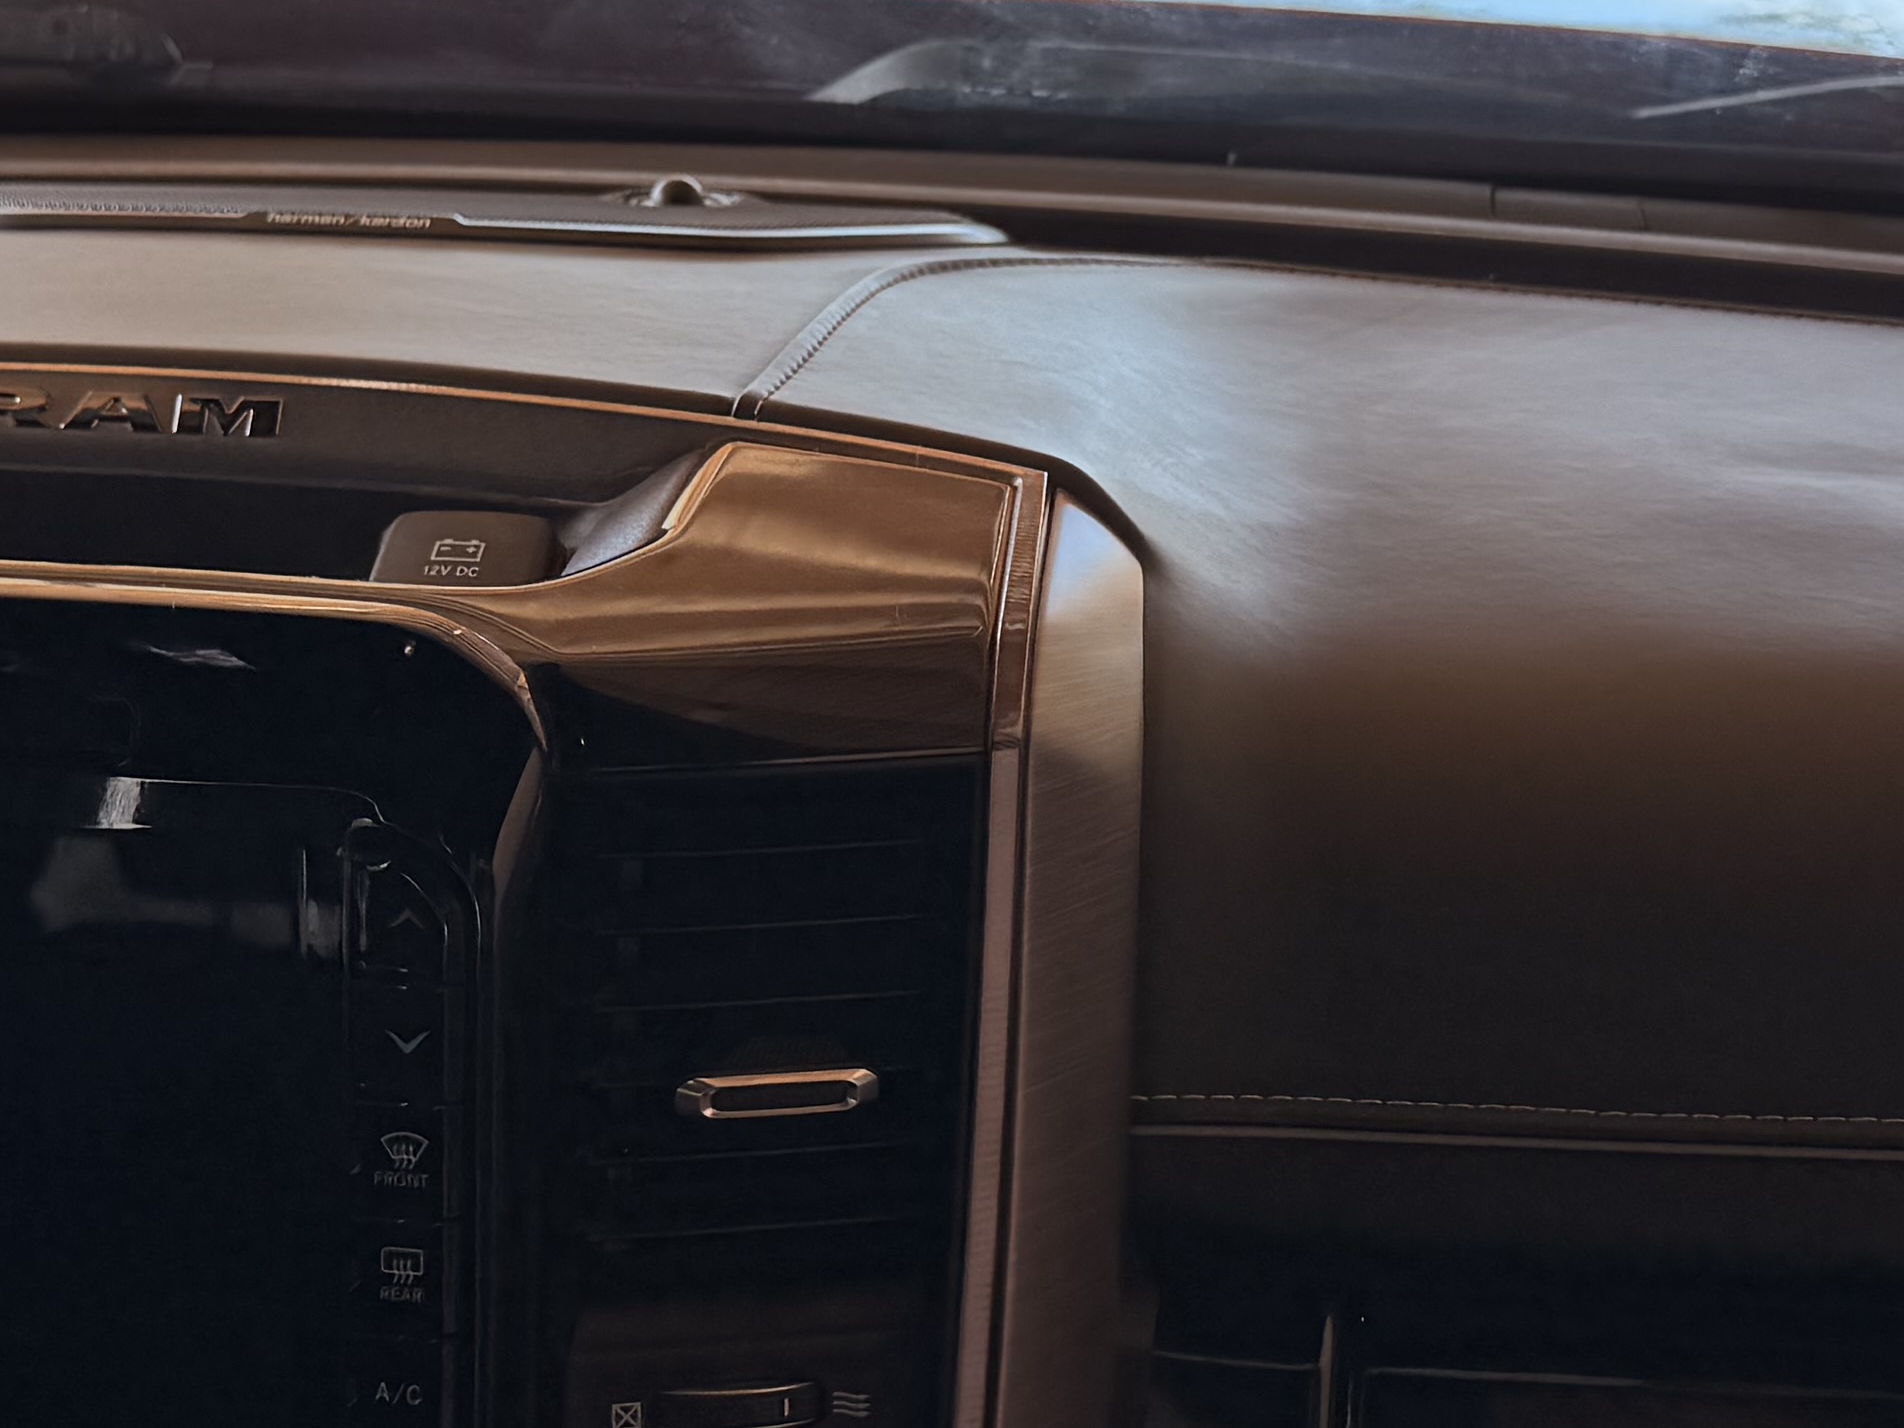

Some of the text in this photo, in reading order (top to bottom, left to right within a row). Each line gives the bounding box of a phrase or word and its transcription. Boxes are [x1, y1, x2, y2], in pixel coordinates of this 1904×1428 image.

[423, 564, 480, 578] 12V DC
[373, 1170, 430, 1189] FRONT
[379, 1285, 424, 1304] REAR
[374, 1380, 423, 1406] A/C
